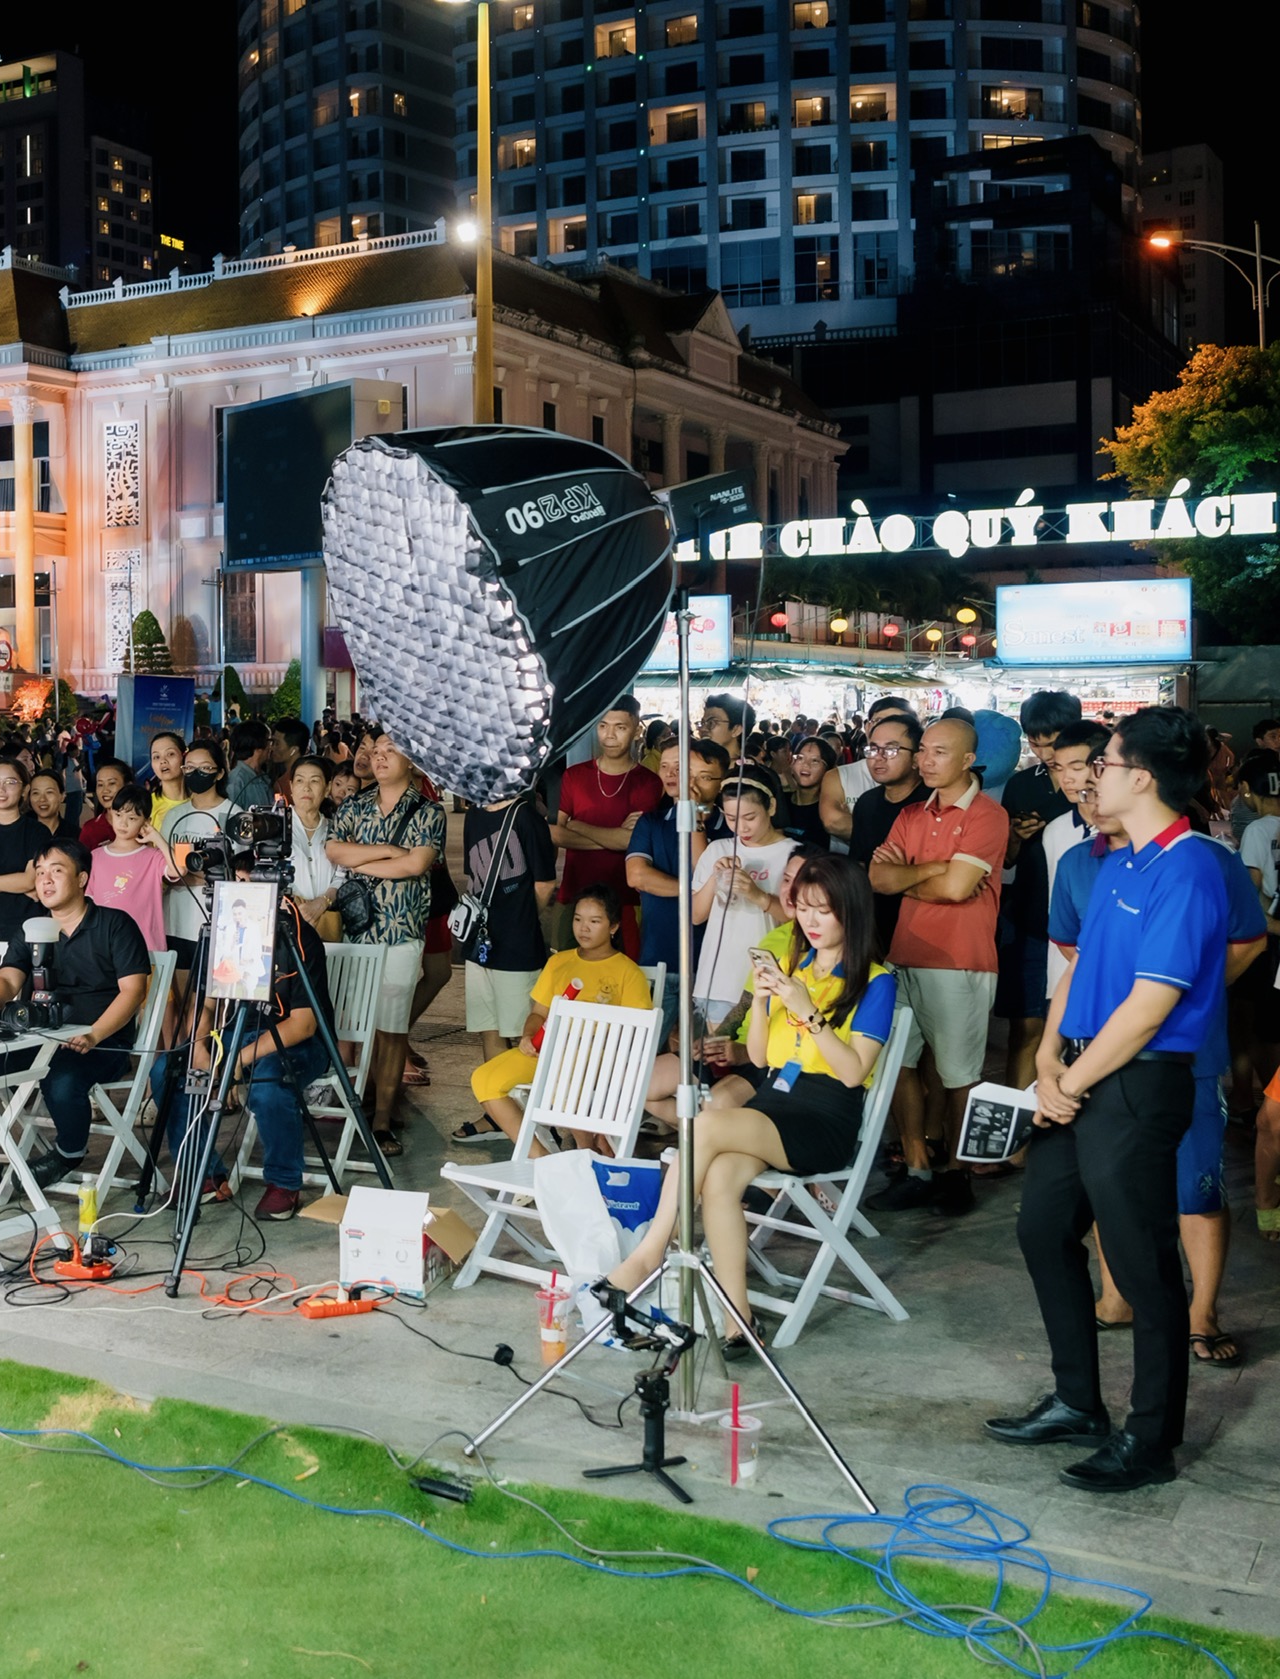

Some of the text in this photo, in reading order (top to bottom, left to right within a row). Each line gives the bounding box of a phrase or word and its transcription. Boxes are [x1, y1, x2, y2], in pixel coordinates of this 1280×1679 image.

[709, 486, 744, 502] NANLITE
[780, 498, 916, 558] CHÀO
[932, 487, 1044, 559] QUÝ
[1065, 477, 1278, 544] KHÁCH
[1003, 617, 1086, 647] Sanest
